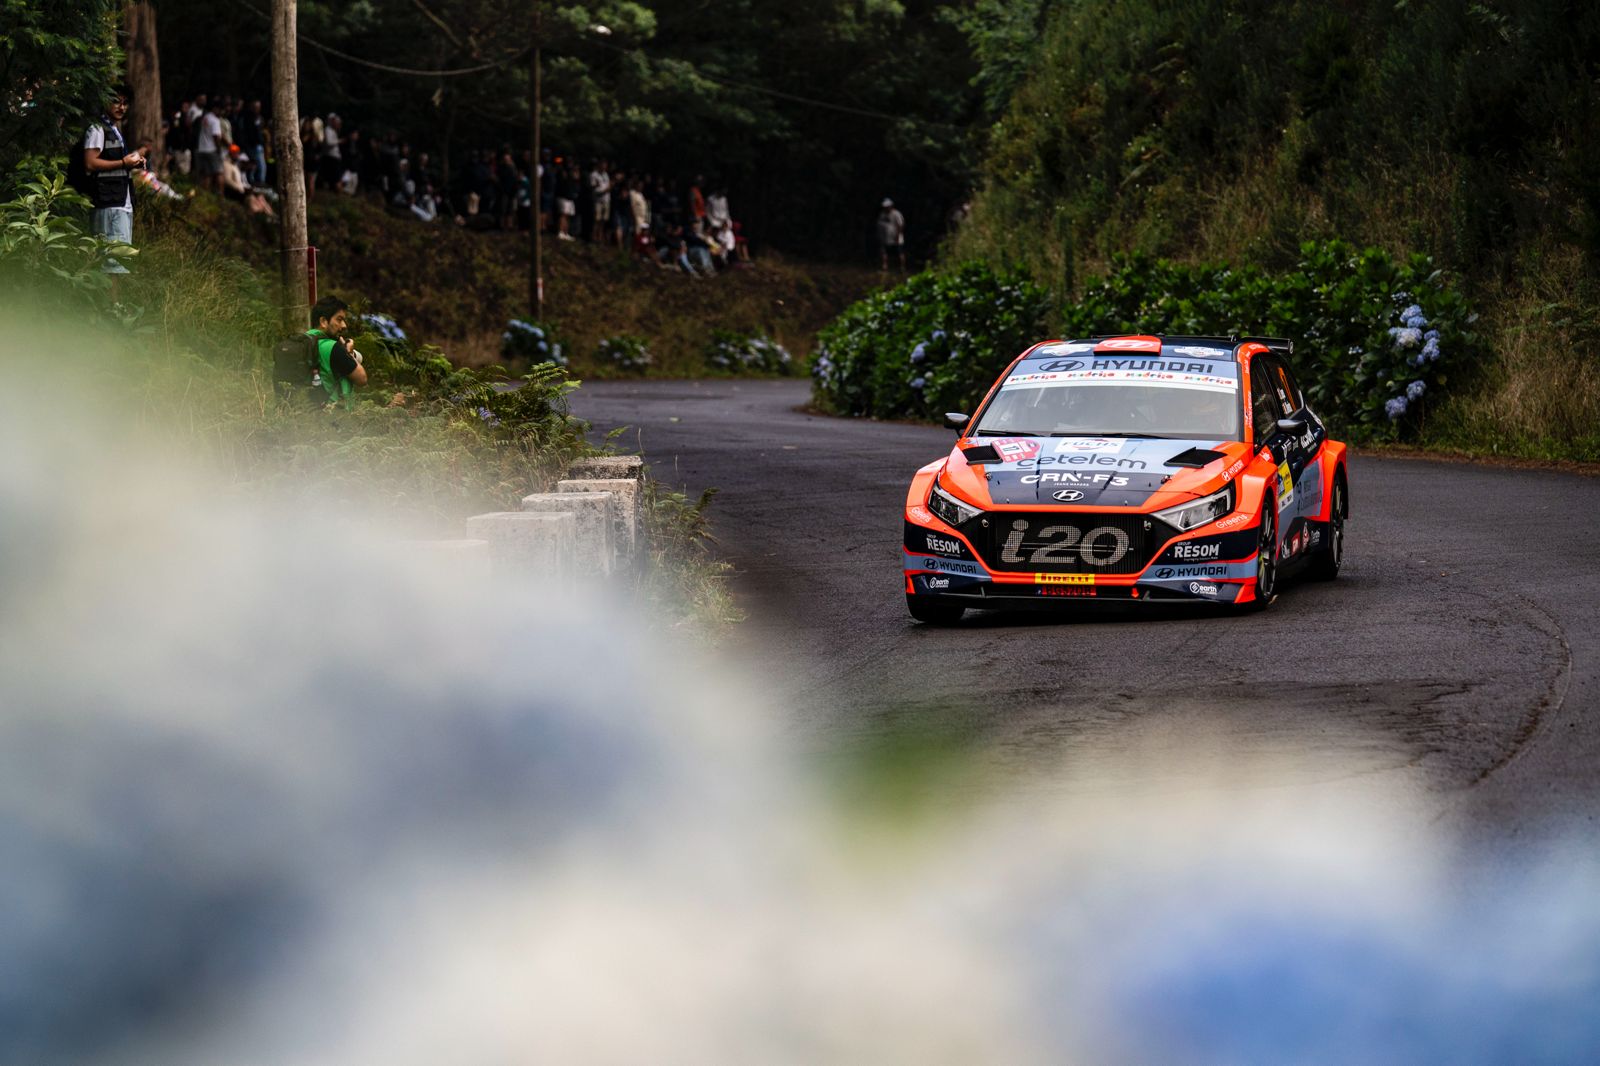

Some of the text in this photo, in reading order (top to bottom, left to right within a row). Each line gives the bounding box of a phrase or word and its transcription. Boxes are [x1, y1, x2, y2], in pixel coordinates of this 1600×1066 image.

[1091, 360, 1214, 374] HYUNDAI
[1016, 454, 1147, 470] cetelem
[1020, 473, 1130, 487] CRN-F3
[926, 537, 960, 554] RESOM
[1001, 519, 1130, 566] i20
[1174, 544, 1220, 558] RESOM
[940, 561, 977, 574] HYUNDAI
[1178, 566, 1227, 577] HYUNDAI
